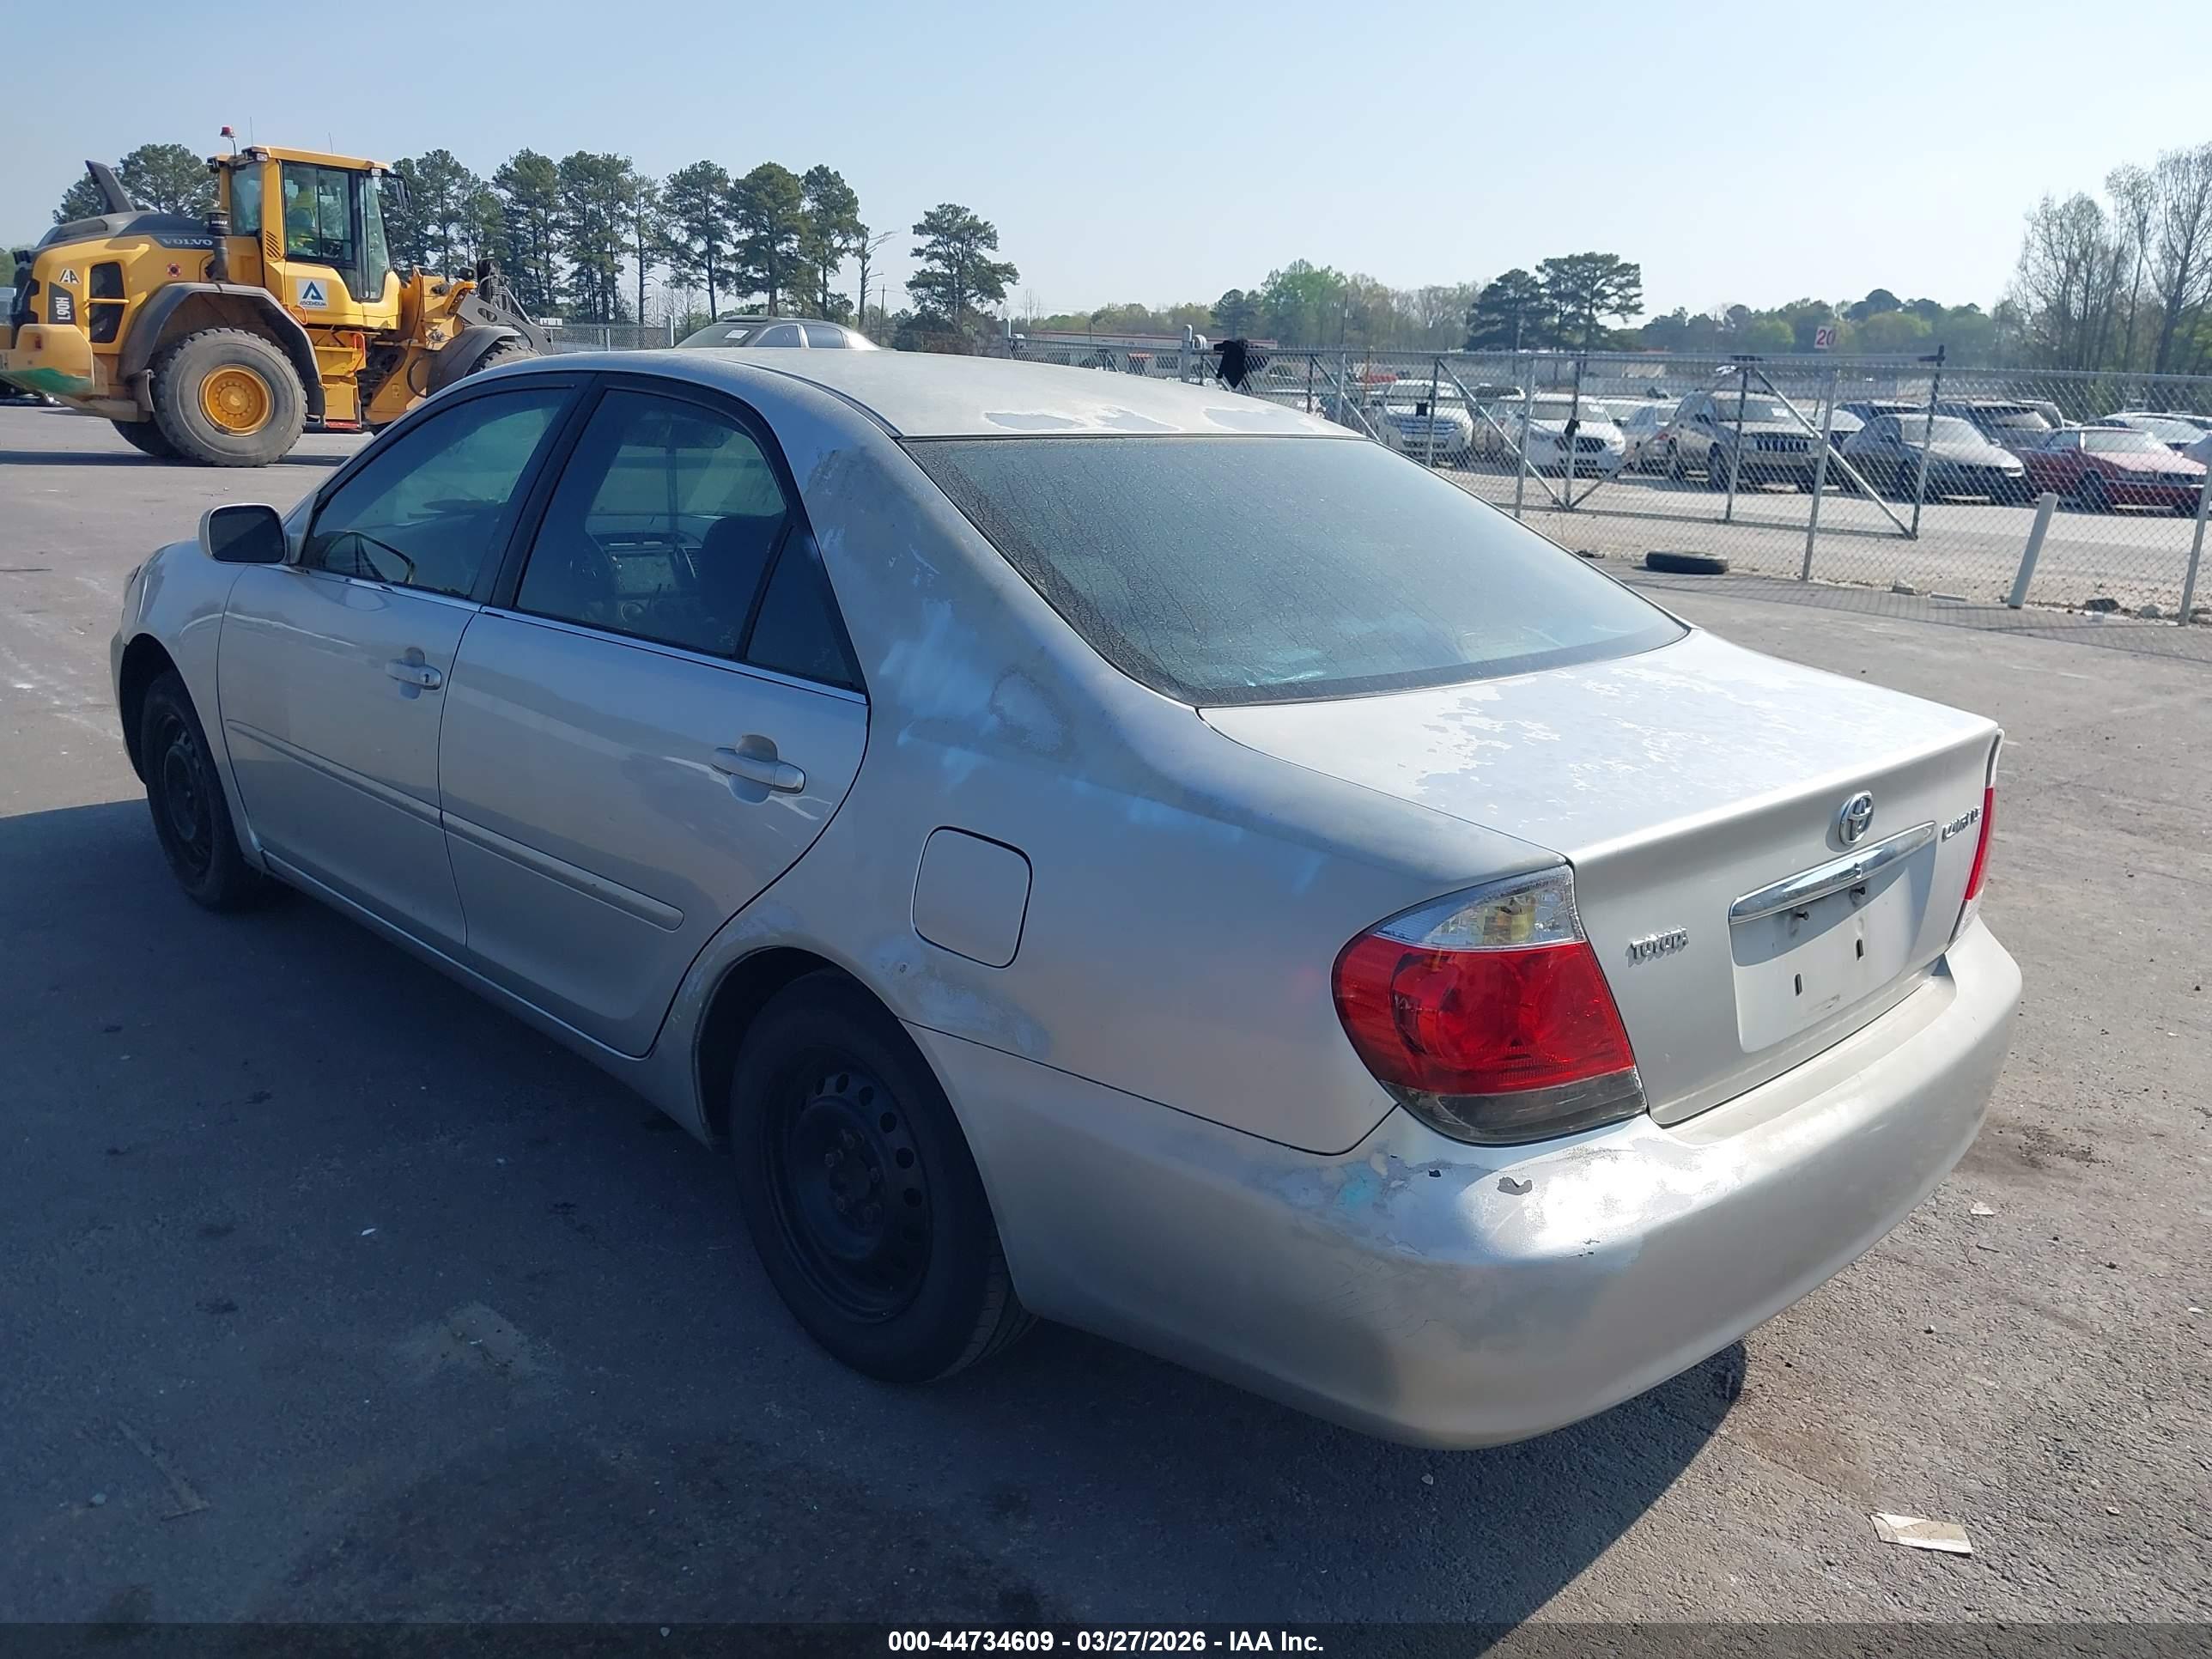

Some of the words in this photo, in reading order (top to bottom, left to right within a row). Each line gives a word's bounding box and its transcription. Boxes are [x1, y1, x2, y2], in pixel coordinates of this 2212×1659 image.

[161, 238, 213, 246] VOLVO
[55, 297, 71, 320] L90H
[1816, 329, 1836, 346] 20
[1630, 927, 1688, 962] TOYOTA
